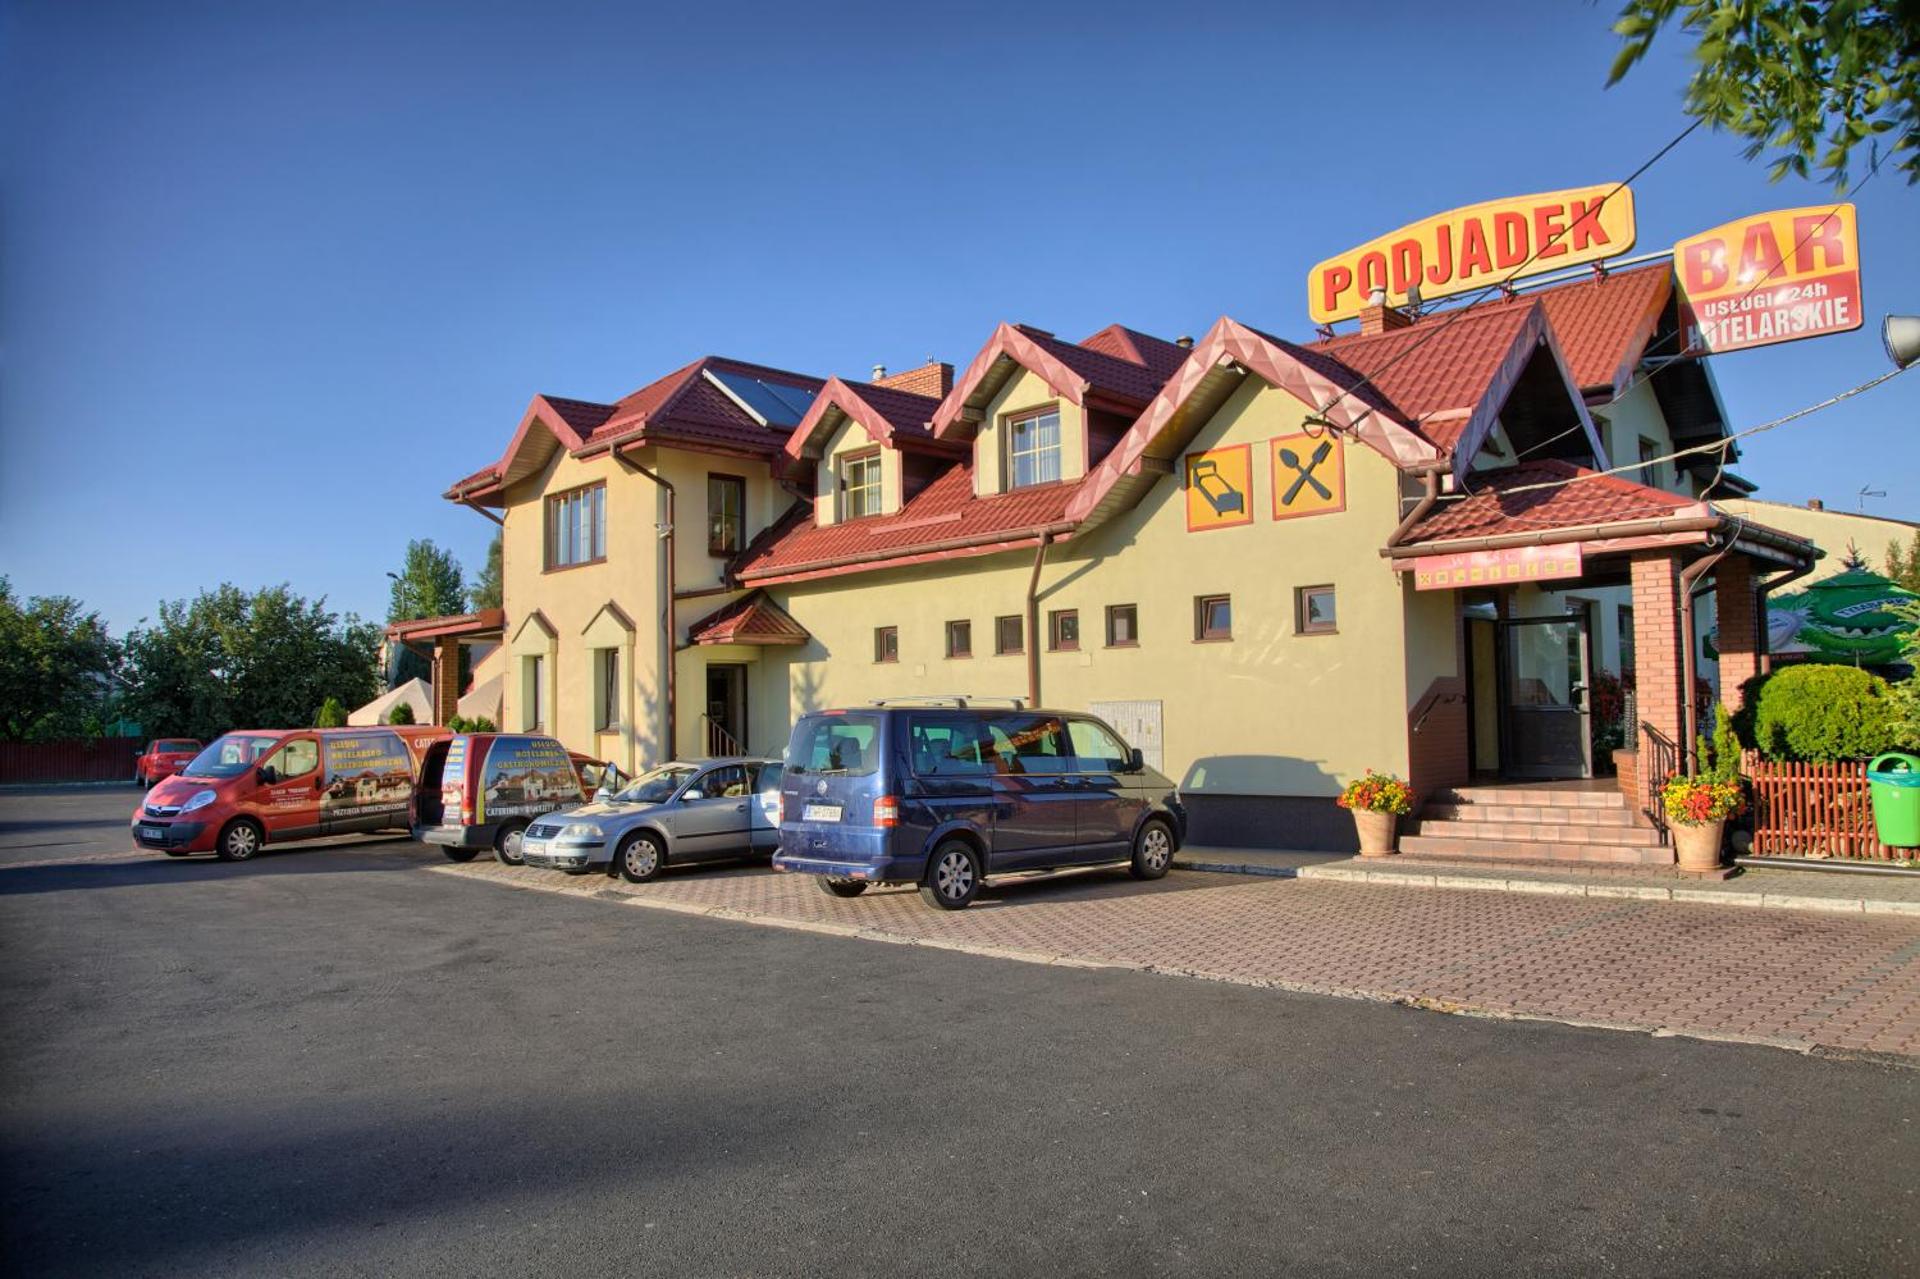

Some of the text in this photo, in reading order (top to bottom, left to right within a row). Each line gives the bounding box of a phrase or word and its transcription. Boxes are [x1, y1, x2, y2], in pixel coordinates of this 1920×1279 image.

[1323, 195, 1610, 312] PODJADEK
[1684, 213, 1846, 295] BAR
[1687, 296, 1850, 351] HOTELARSKIE
[1704, 282, 1828, 317] USŁUGI 24h
